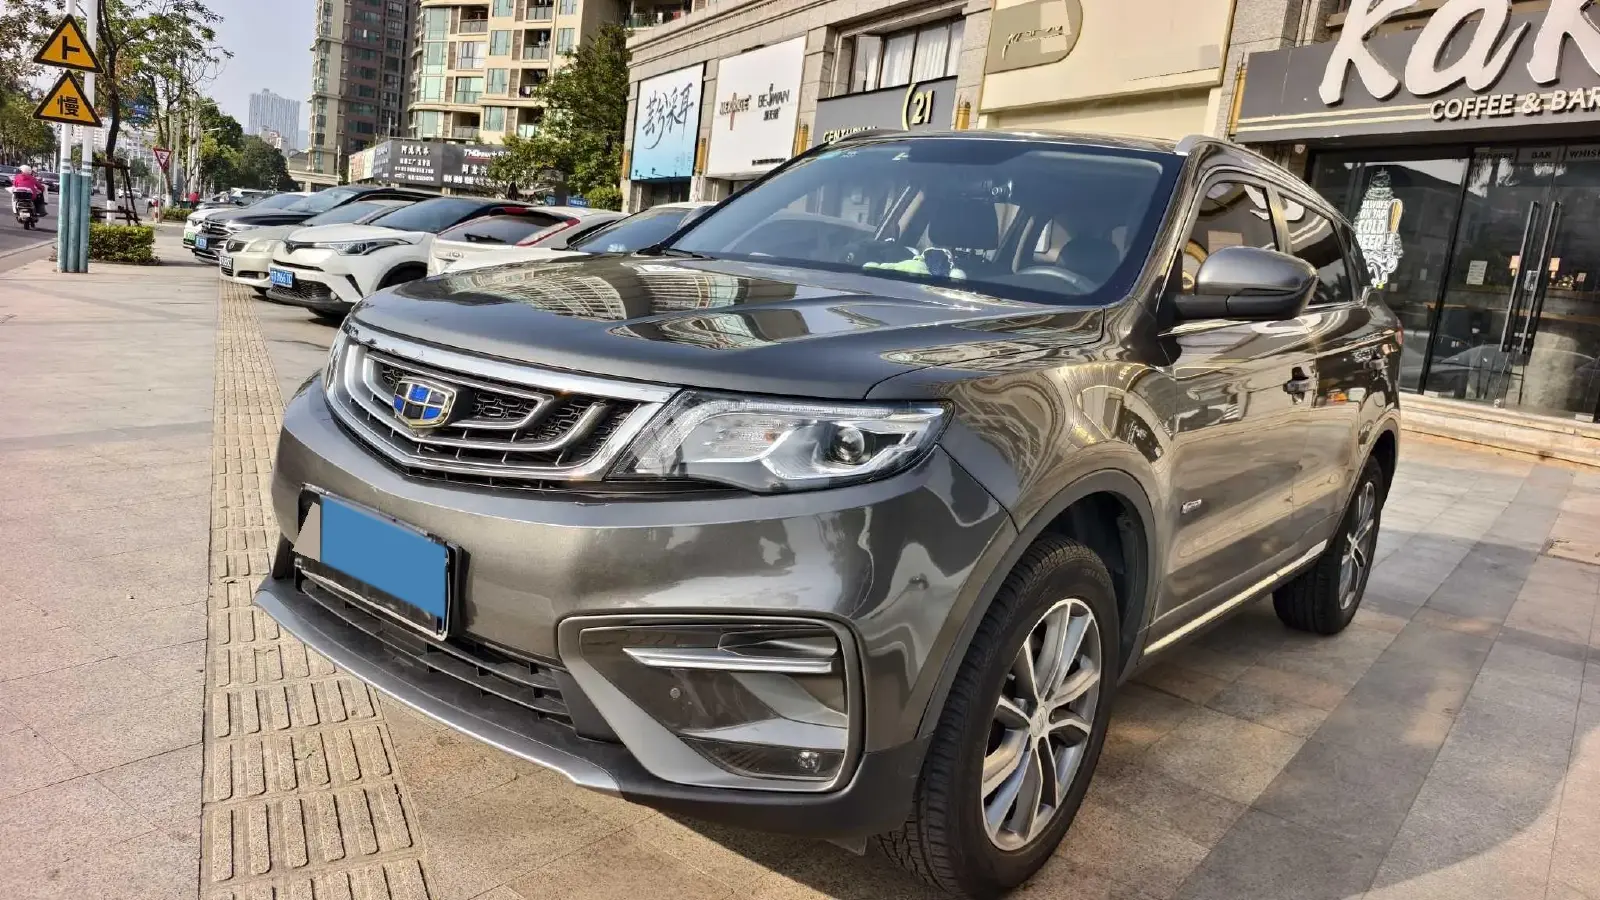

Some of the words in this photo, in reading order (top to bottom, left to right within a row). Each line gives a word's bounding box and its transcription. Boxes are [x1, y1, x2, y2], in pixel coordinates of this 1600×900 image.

[57, 95, 79, 117] 慢
[1430, 94, 1514, 120] COFFEE
[1522, 92, 1541, 114] &
[1550, 87, 1600, 111] BAR
[1360, 209, 1371, 219] ON
[1372, 209, 1386, 219] TAP
[1357, 219, 1385, 234] COLD
